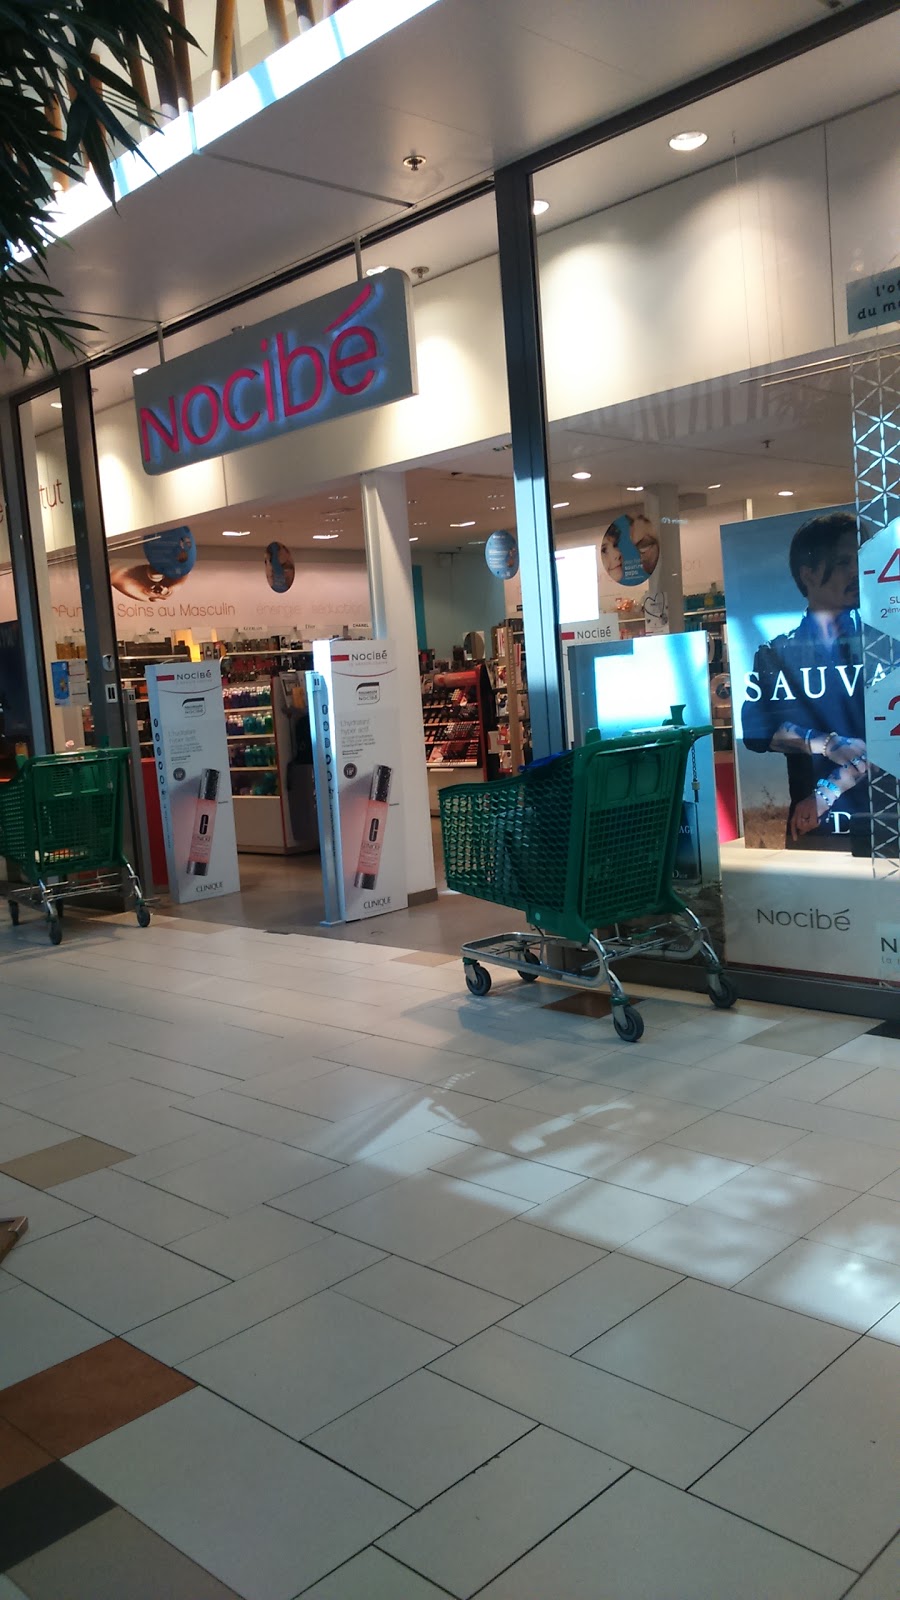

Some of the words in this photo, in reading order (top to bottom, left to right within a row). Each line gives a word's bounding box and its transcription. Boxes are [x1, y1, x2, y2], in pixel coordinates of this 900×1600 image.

[858, 307, 877, 320] du
[117, 603, 154, 618] Soins
[157, 606, 176, 617] au
[179, 602, 236, 617] Masculin
[196, 882, 223, 893] CLINIQUE
[363, 897, 391, 909] CLINIQUE
